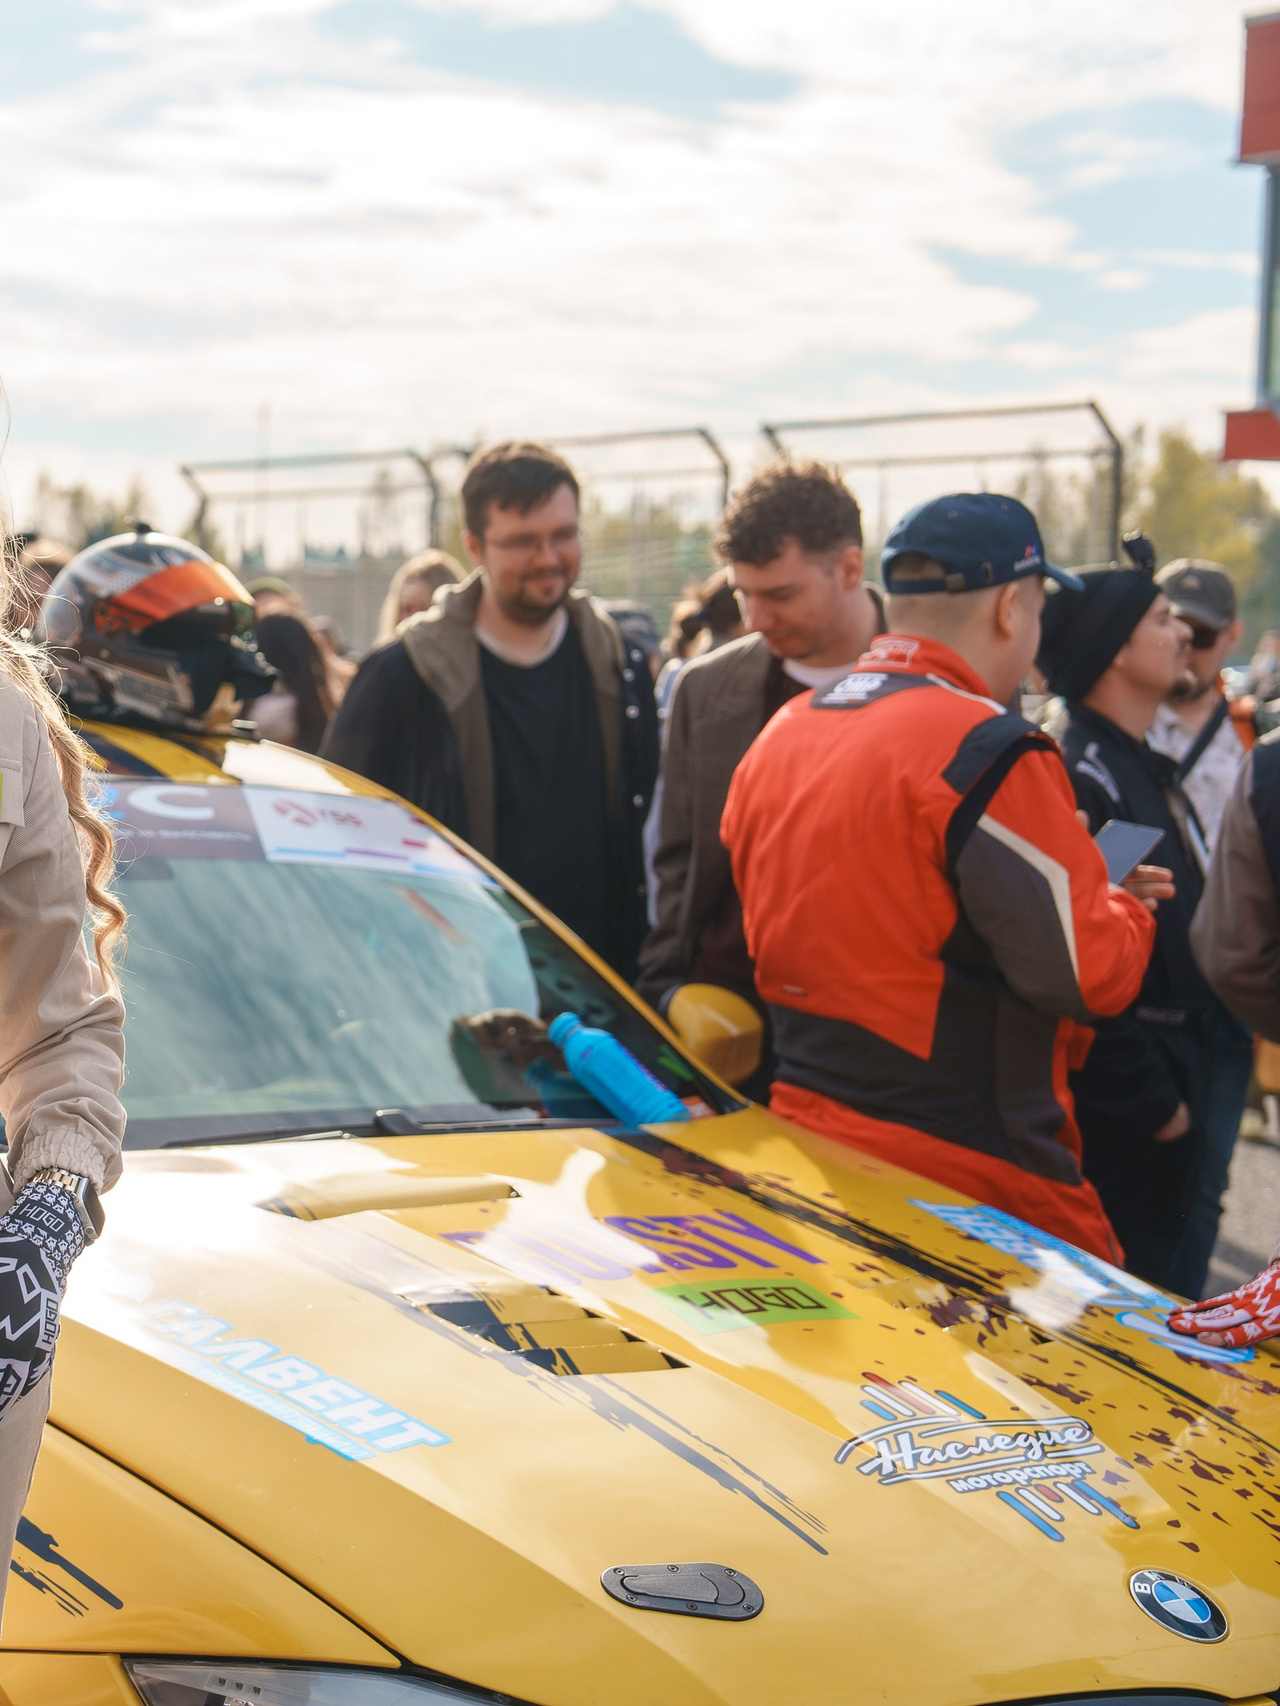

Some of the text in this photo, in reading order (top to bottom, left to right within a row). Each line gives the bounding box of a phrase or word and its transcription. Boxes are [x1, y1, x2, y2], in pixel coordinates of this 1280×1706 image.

[19, 1203, 65, 1232] HOGO
[678, 1286, 828, 1320] HOGO
[41, 1297, 58, 1344] HOGO
[857, 1424, 1094, 1476] Наследие
[948, 1460, 1096, 1493] моторспорт
